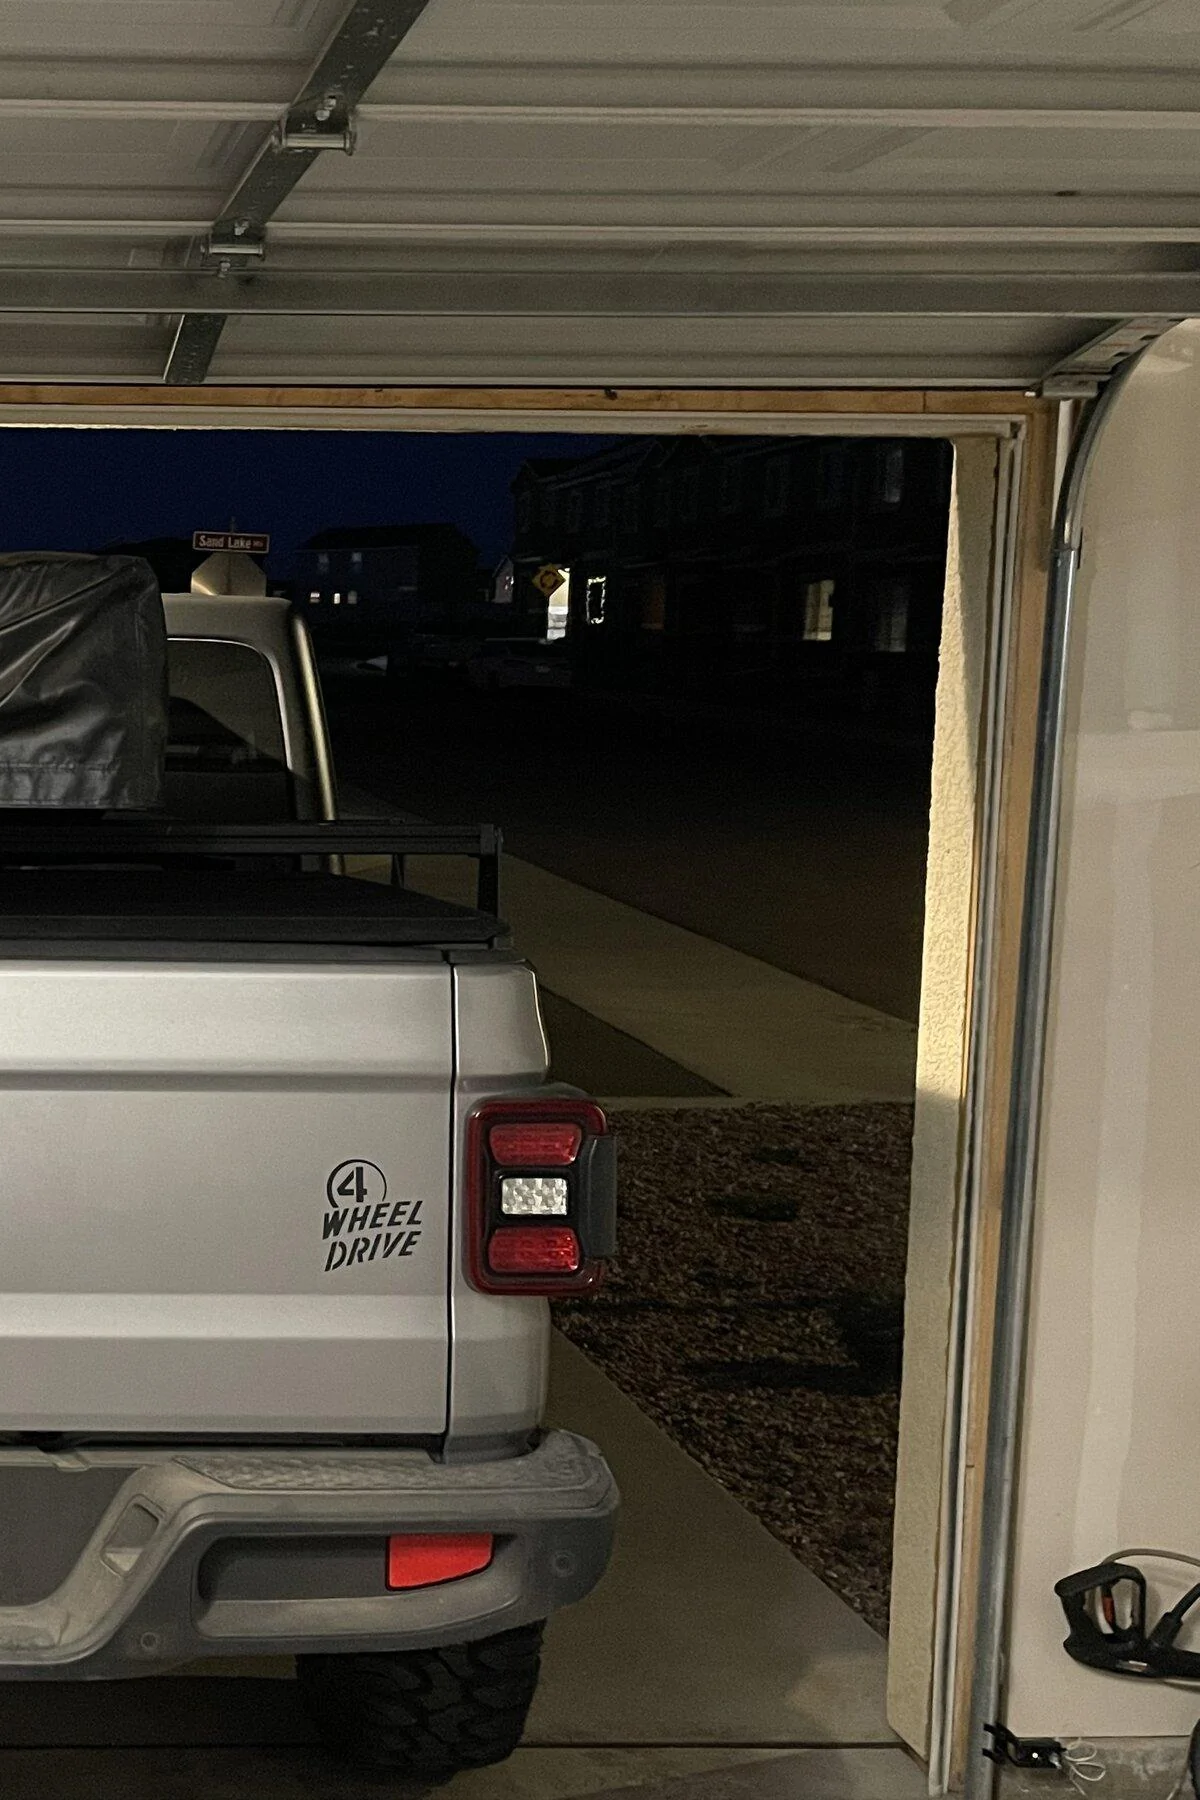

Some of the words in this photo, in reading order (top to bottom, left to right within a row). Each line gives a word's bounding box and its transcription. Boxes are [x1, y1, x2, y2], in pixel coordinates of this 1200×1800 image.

[199, 535, 225, 548] Sand
[228, 537, 252, 549] Lake
[336, 1166, 368, 1203] 4
[322, 1200, 423, 1240] WHEEL
[324, 1231, 422, 1272] DRIVE
